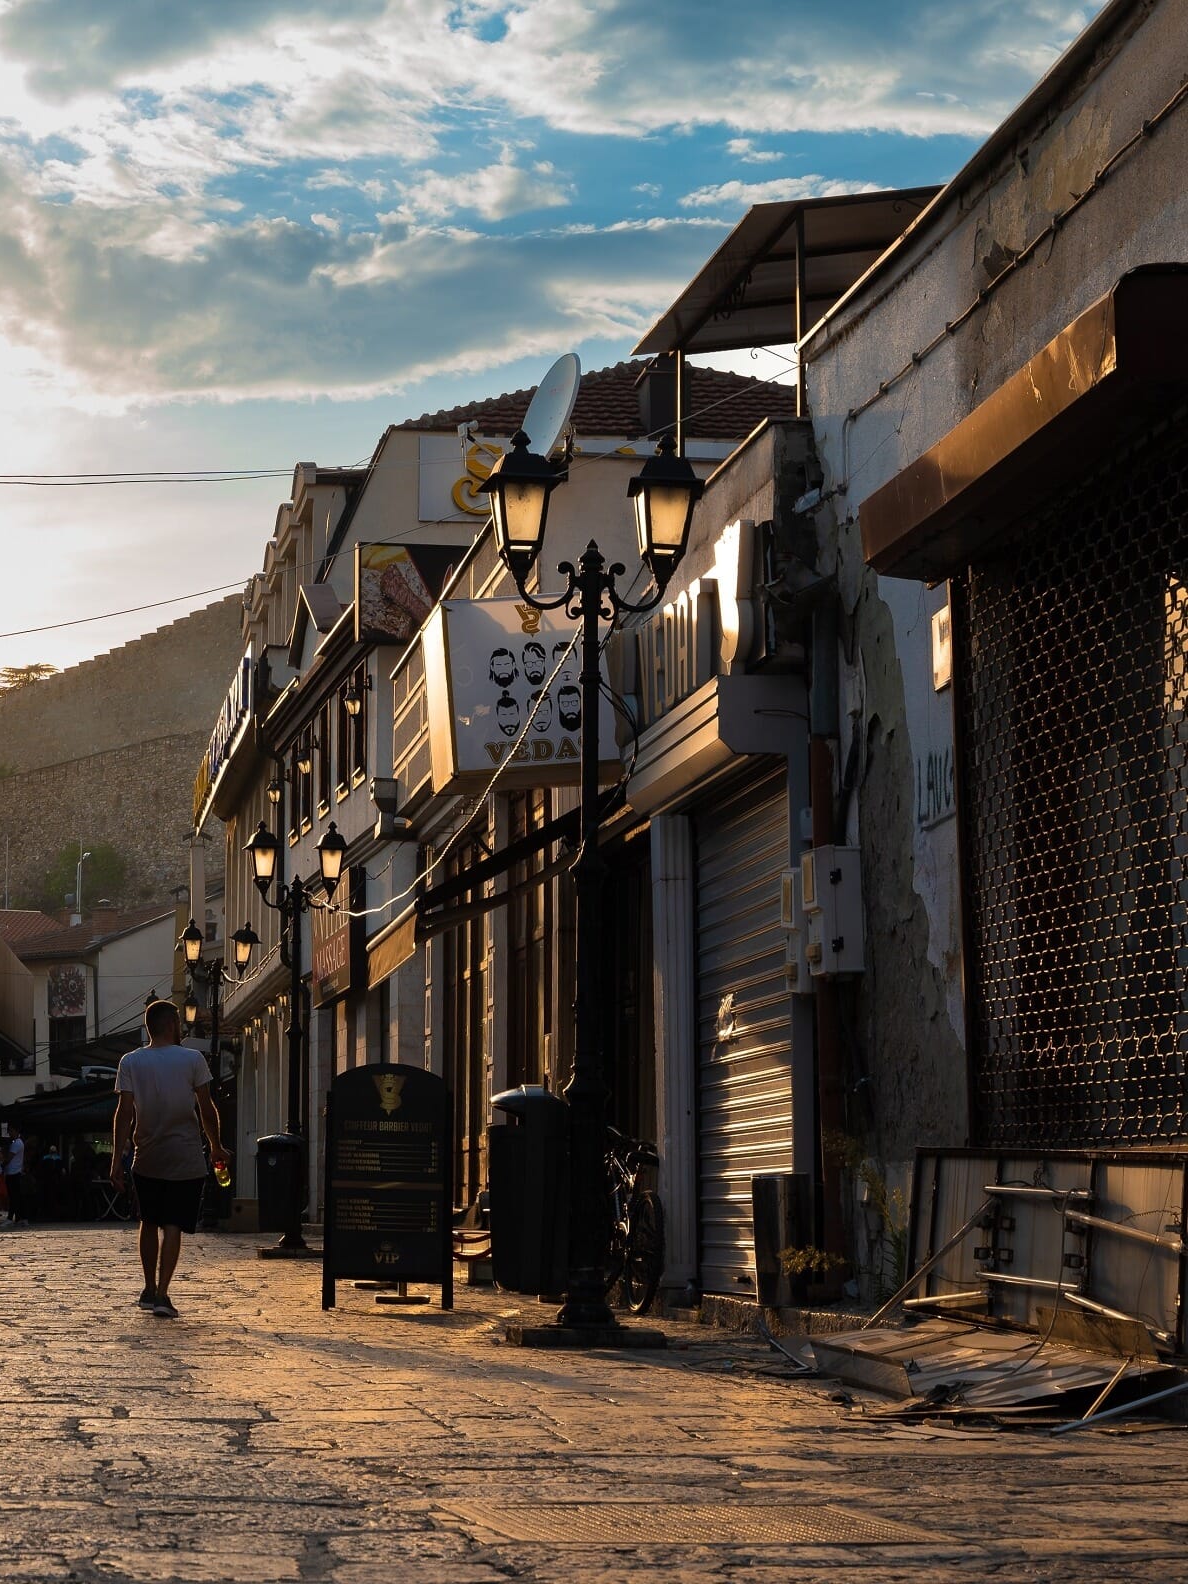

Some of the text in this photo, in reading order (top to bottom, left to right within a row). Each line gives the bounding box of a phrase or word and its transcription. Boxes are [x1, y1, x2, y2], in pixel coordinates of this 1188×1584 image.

[635, 577, 705, 725] VEDAT
[484, 735, 582, 766] VEDA
[316, 935, 346, 982] MASSAGE
[374, 1252, 400, 1264] VIP
